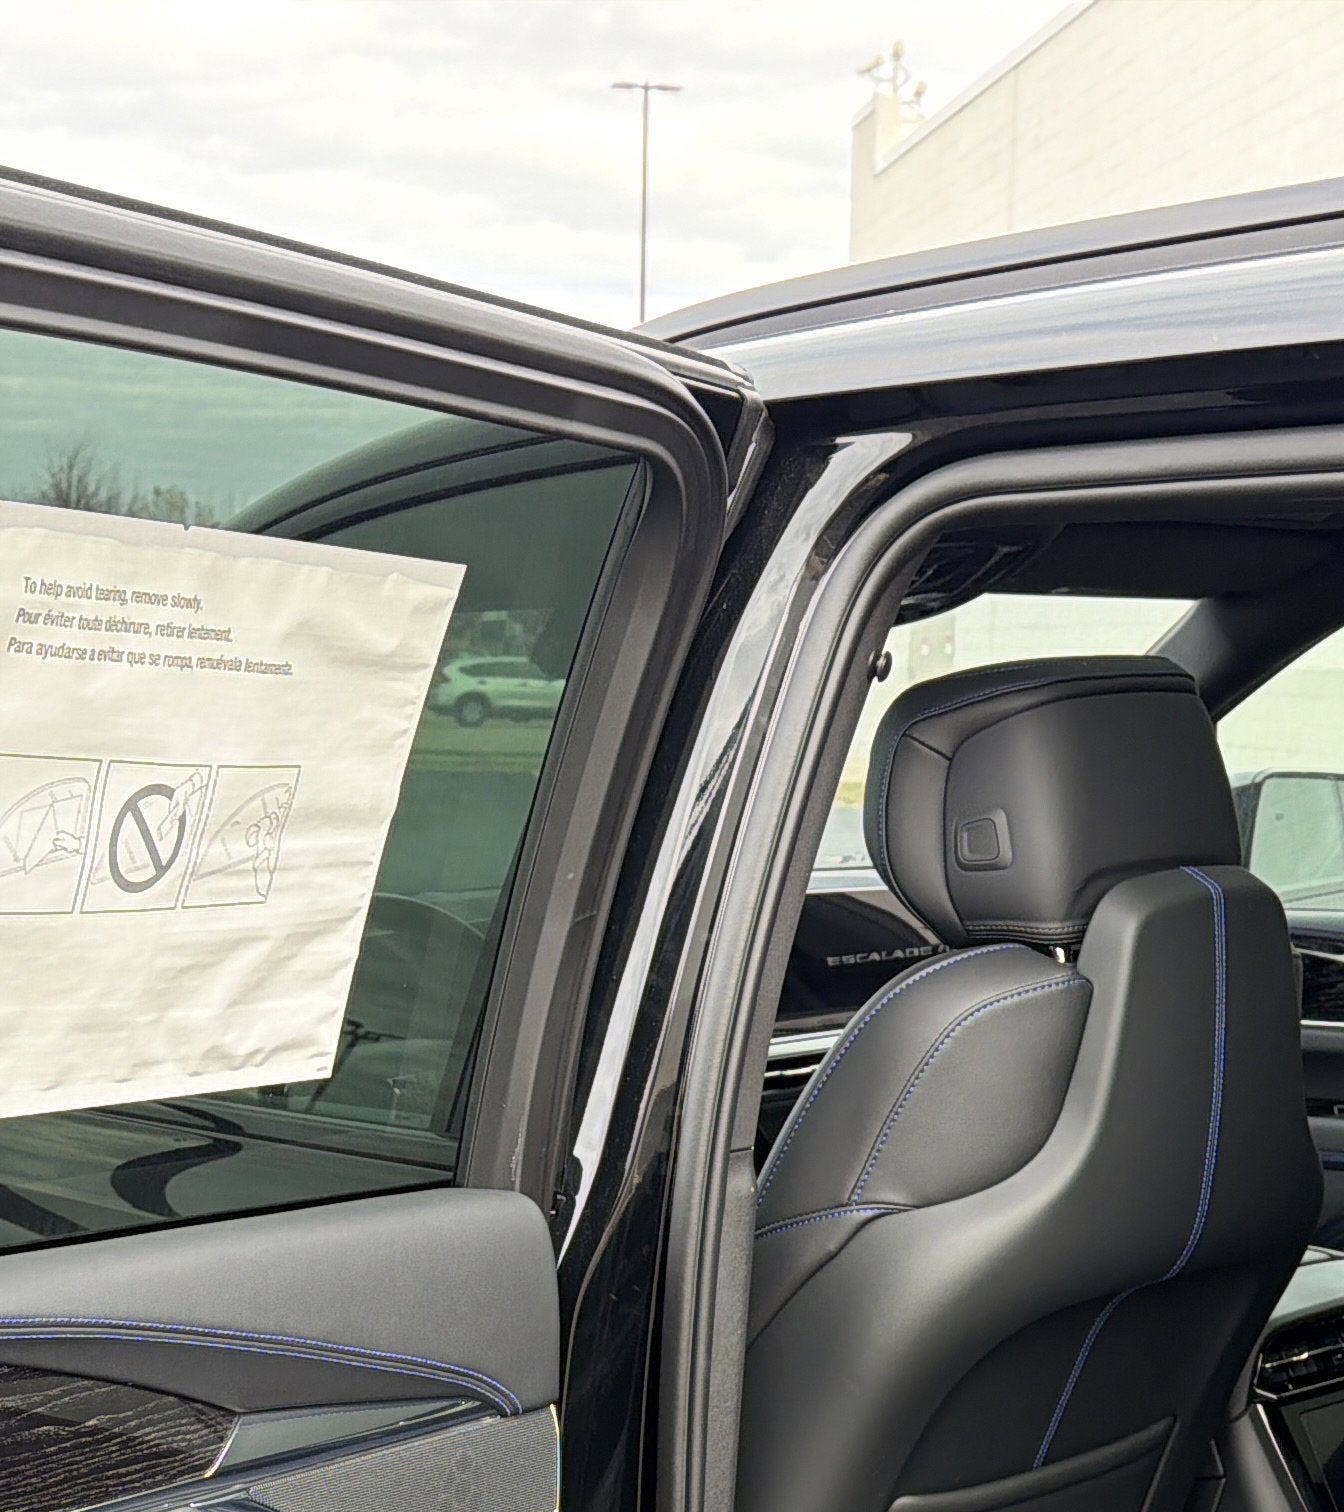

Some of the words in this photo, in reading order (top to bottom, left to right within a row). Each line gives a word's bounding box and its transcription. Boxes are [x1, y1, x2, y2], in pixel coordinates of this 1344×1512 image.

[23, 576, 37, 595] To
[39, 578, 63, 600] help
[65, 582, 93, 599] avoid
[95, 583, 128, 606] tearing,
[130, 590, 168, 606] remove
[170, 592, 203, 614] slowly.
[15, 607, 42, 624] Pour
[43, 609, 76, 628] éviter
[78, 614, 103, 631] toute
[104, 615, 152, 638] déchirure,
[155, 621, 186, 639] retirer
[7, 636, 33, 654] Para
[36, 642, 87, 660] ayudarse
[89, 648, 96, 661] a
[97, 645, 125, 662] evitar
[127, 650, 146, 667] que
[148, 653, 161, 666] se
[163, 654, 193, 672] rompa,
[827, 945, 933, 967] ESCALADE
